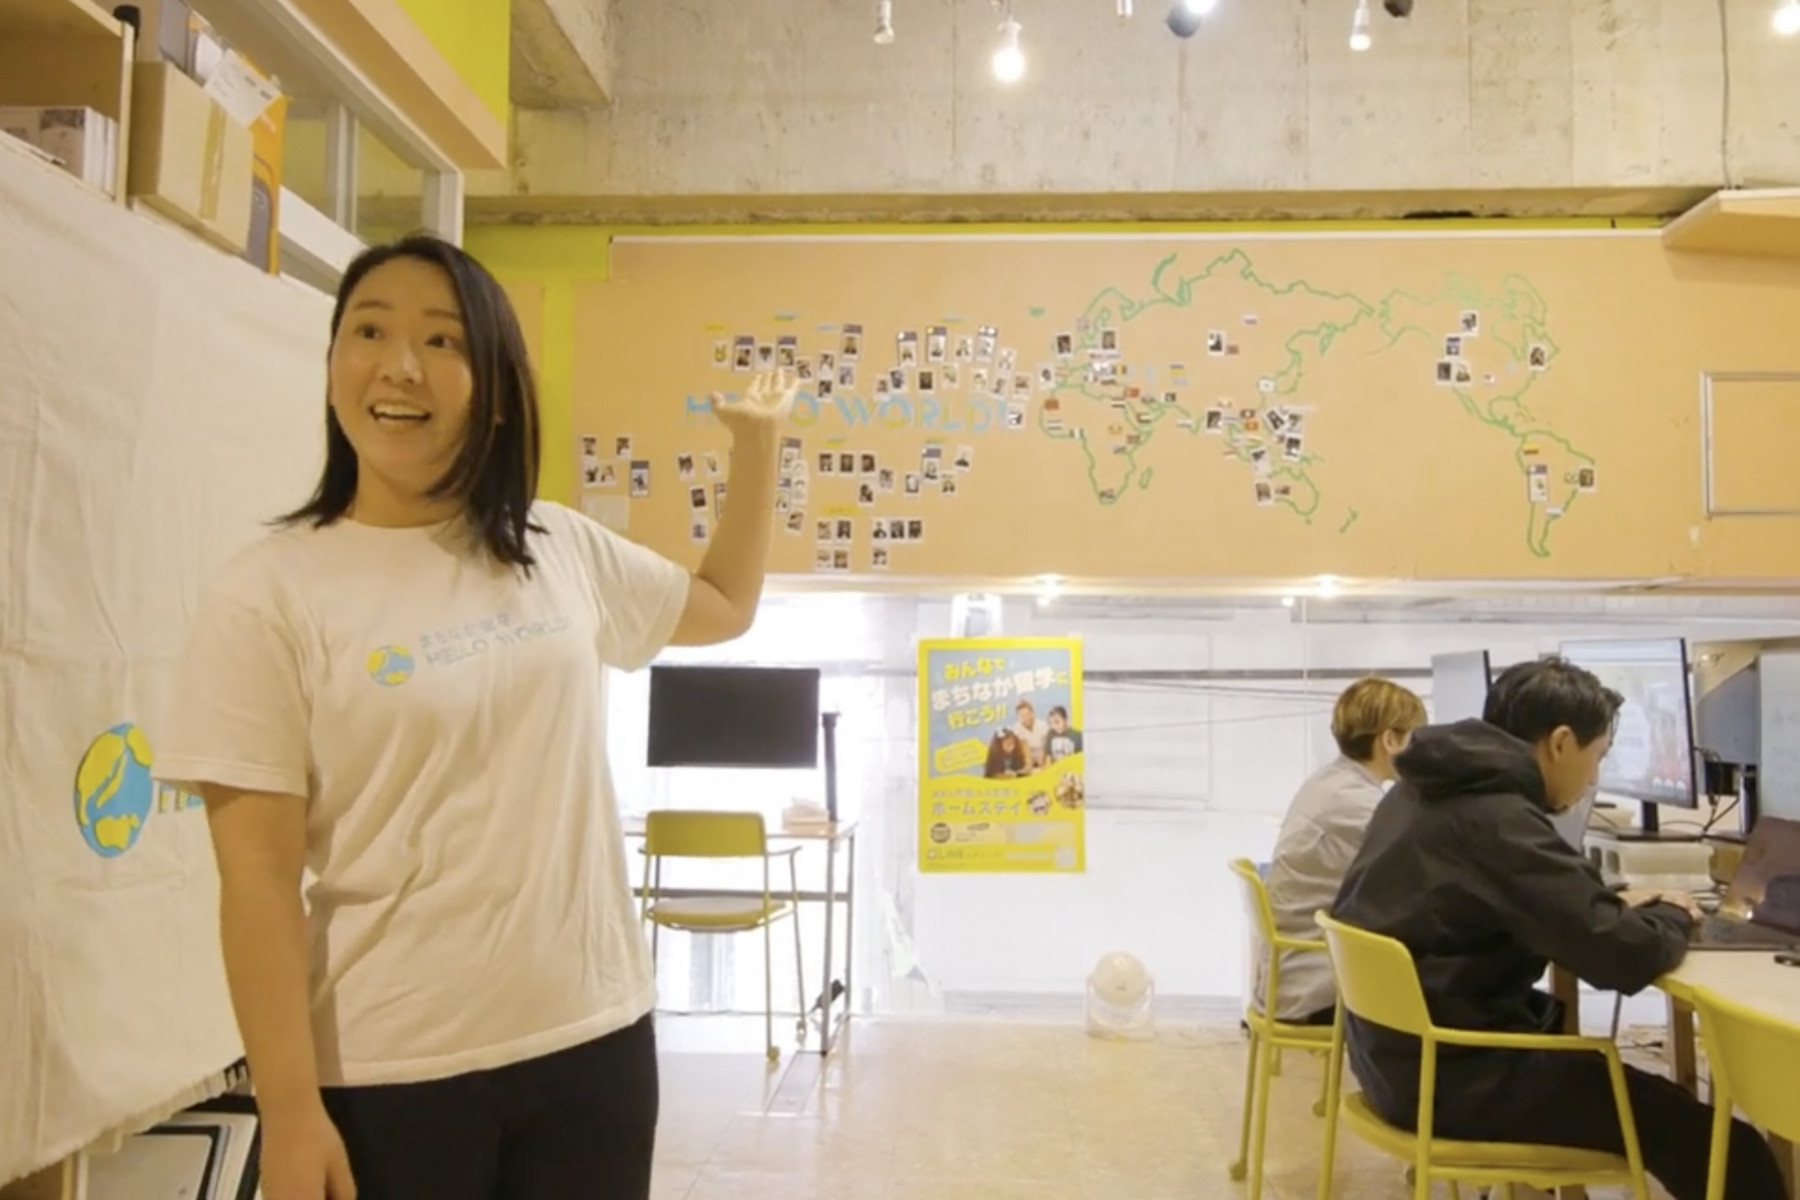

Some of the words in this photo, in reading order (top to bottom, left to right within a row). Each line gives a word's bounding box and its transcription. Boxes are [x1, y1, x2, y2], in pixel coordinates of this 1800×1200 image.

[943, 656, 1006, 681] みんなで
[932, 801, 1022, 815] ホームステイ
